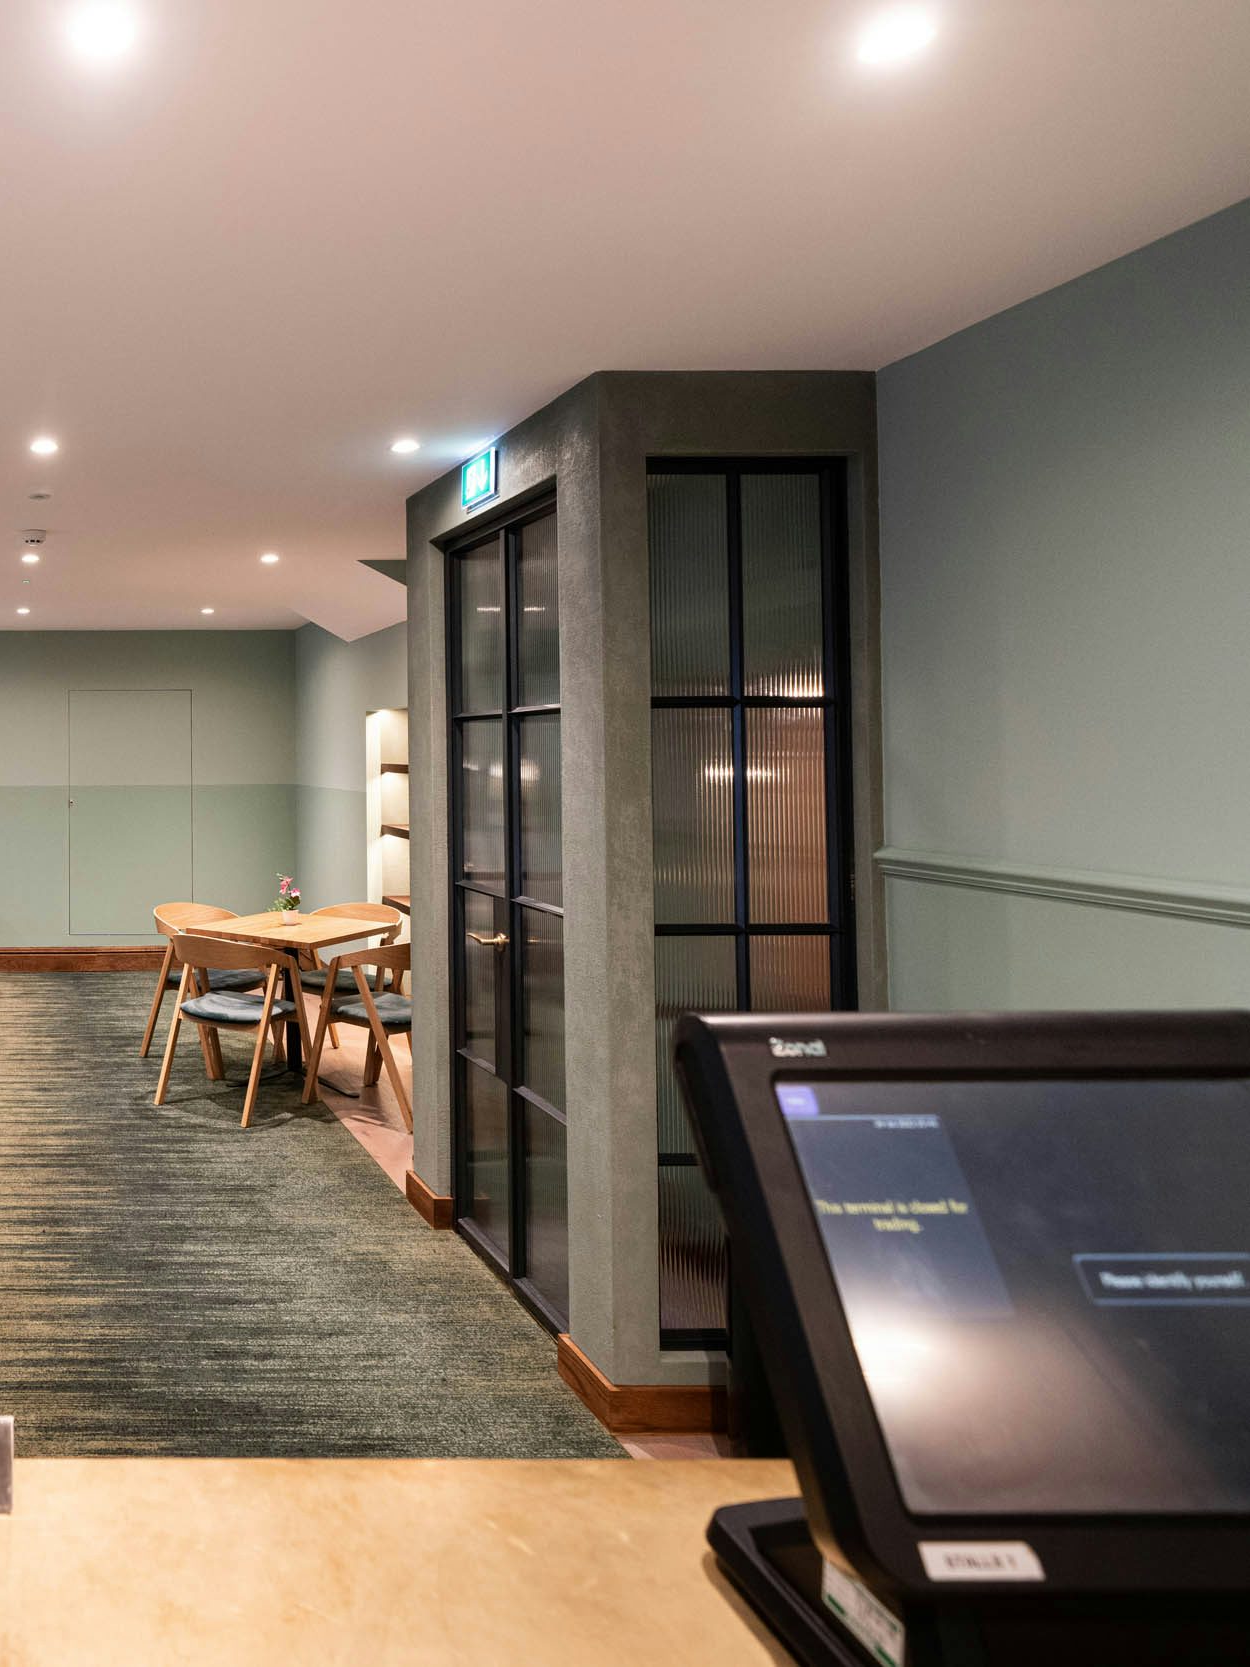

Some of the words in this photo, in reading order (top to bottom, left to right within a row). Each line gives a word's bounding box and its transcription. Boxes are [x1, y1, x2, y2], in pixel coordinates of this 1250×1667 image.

[843, 1200, 895, 1215] terminal
[896, 1201, 909, 1215] is
[908, 1200, 949, 1215] closed
[947, 1198, 969, 1215] for
[1099, 1271, 1143, 1290] Please
[1143, 1271, 1193, 1292] identify
